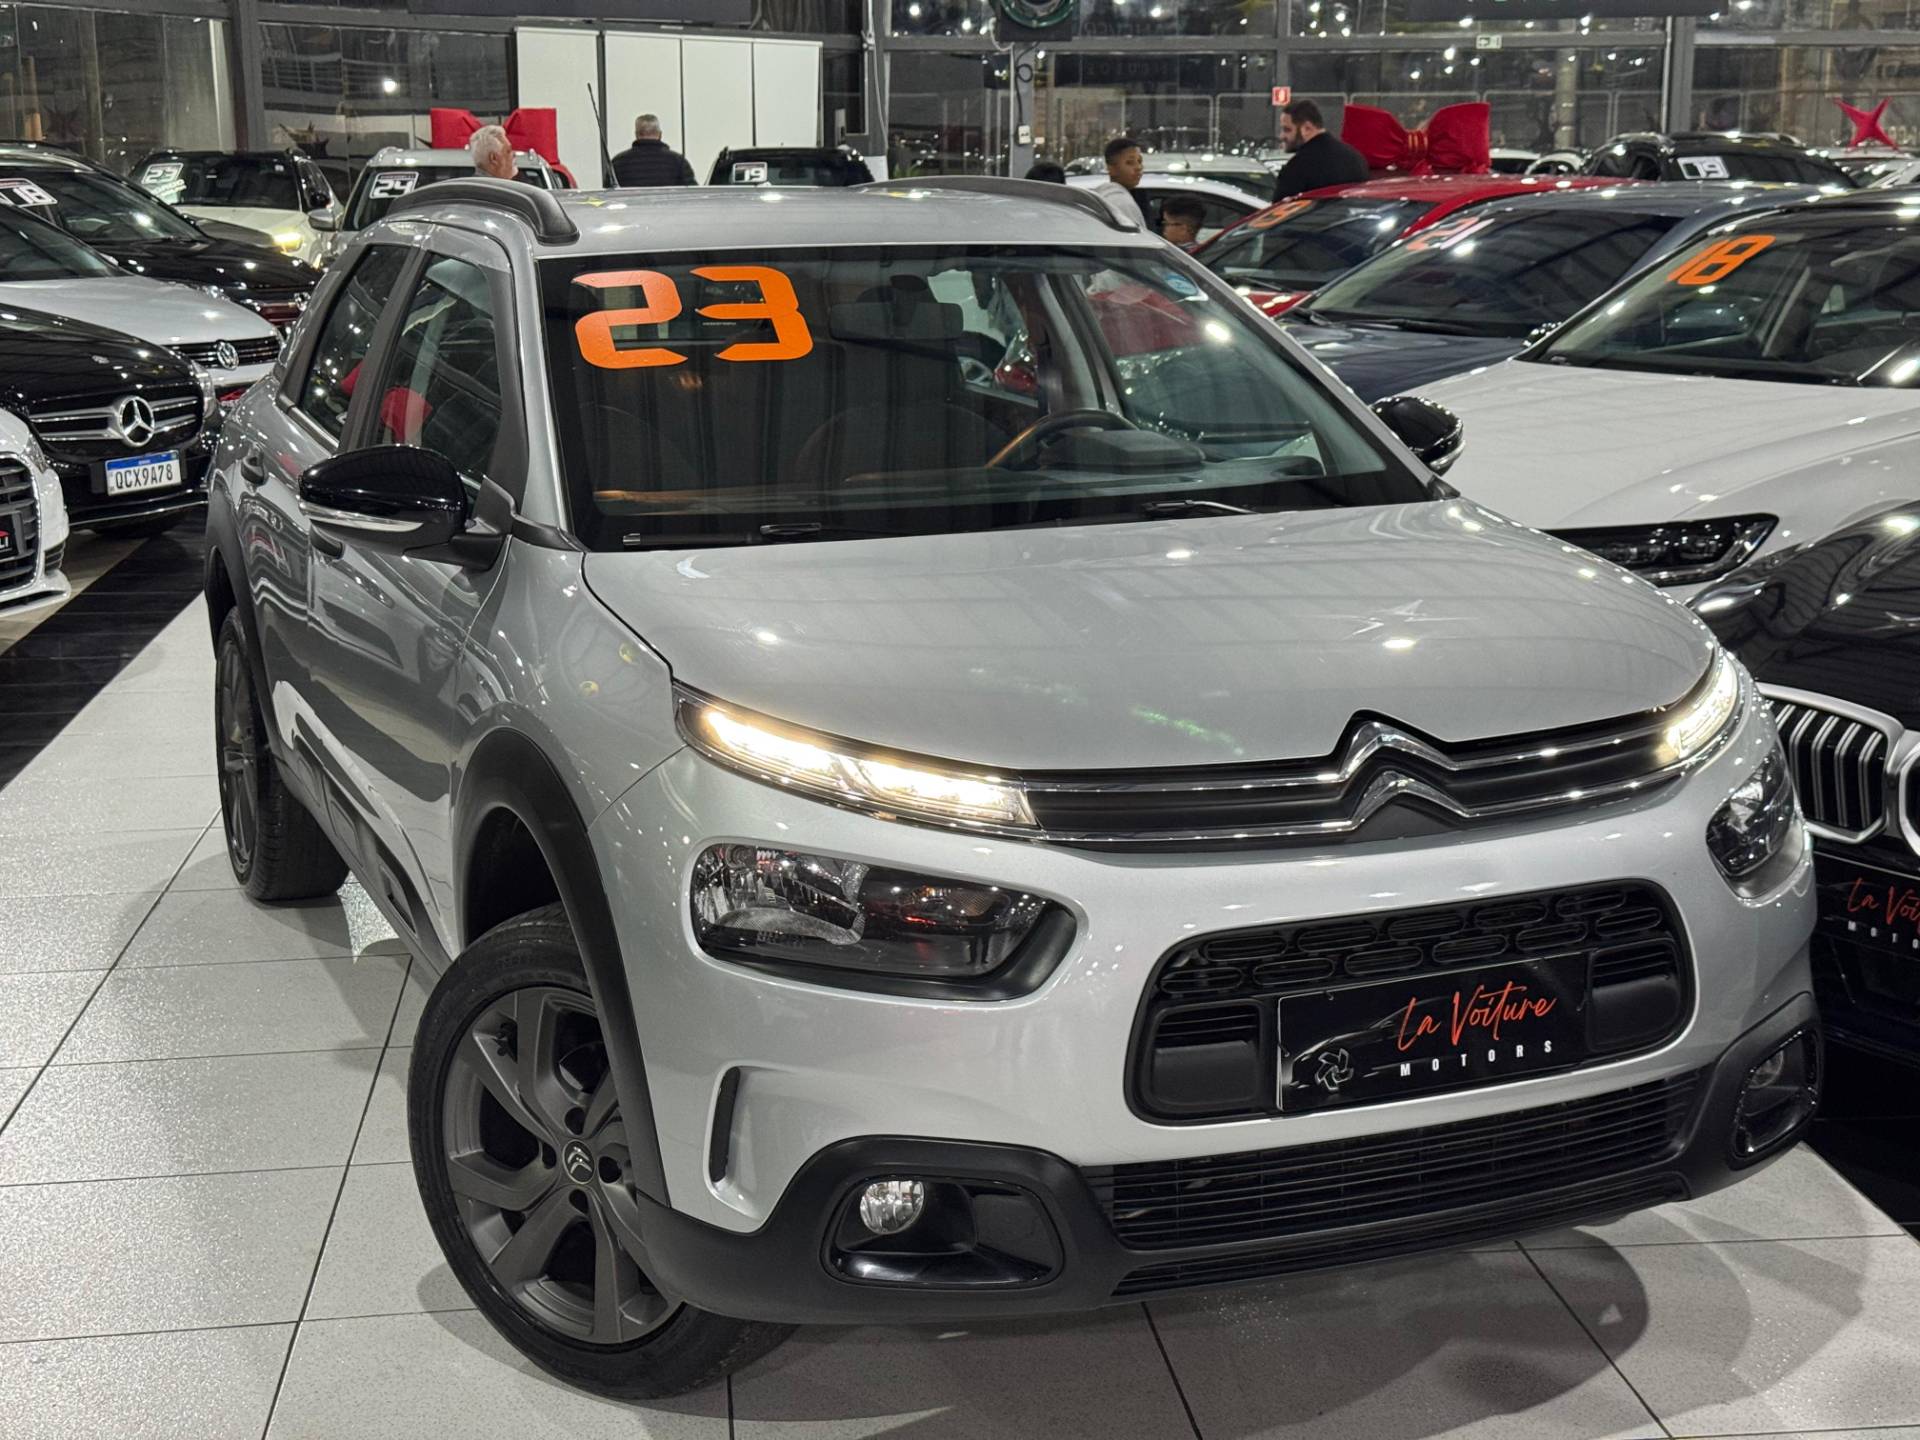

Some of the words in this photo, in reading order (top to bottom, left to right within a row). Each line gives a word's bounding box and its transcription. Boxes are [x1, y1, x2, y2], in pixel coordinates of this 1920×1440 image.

[373, 179, 413, 197] 24
[744, 167, 765, 181] 19
[13, 185, 52, 203] 18
[1665, 234, 1776, 285] 18
[570, 265, 814, 369] 23
[115, 463, 173, 489] QCX9A78
[1847, 877, 1880, 912] La
[1397, 997, 1442, 1050] La
[1451, 981, 1557, 1046] Voiture
[1400, 1040, 1553, 1077] MOTORS
